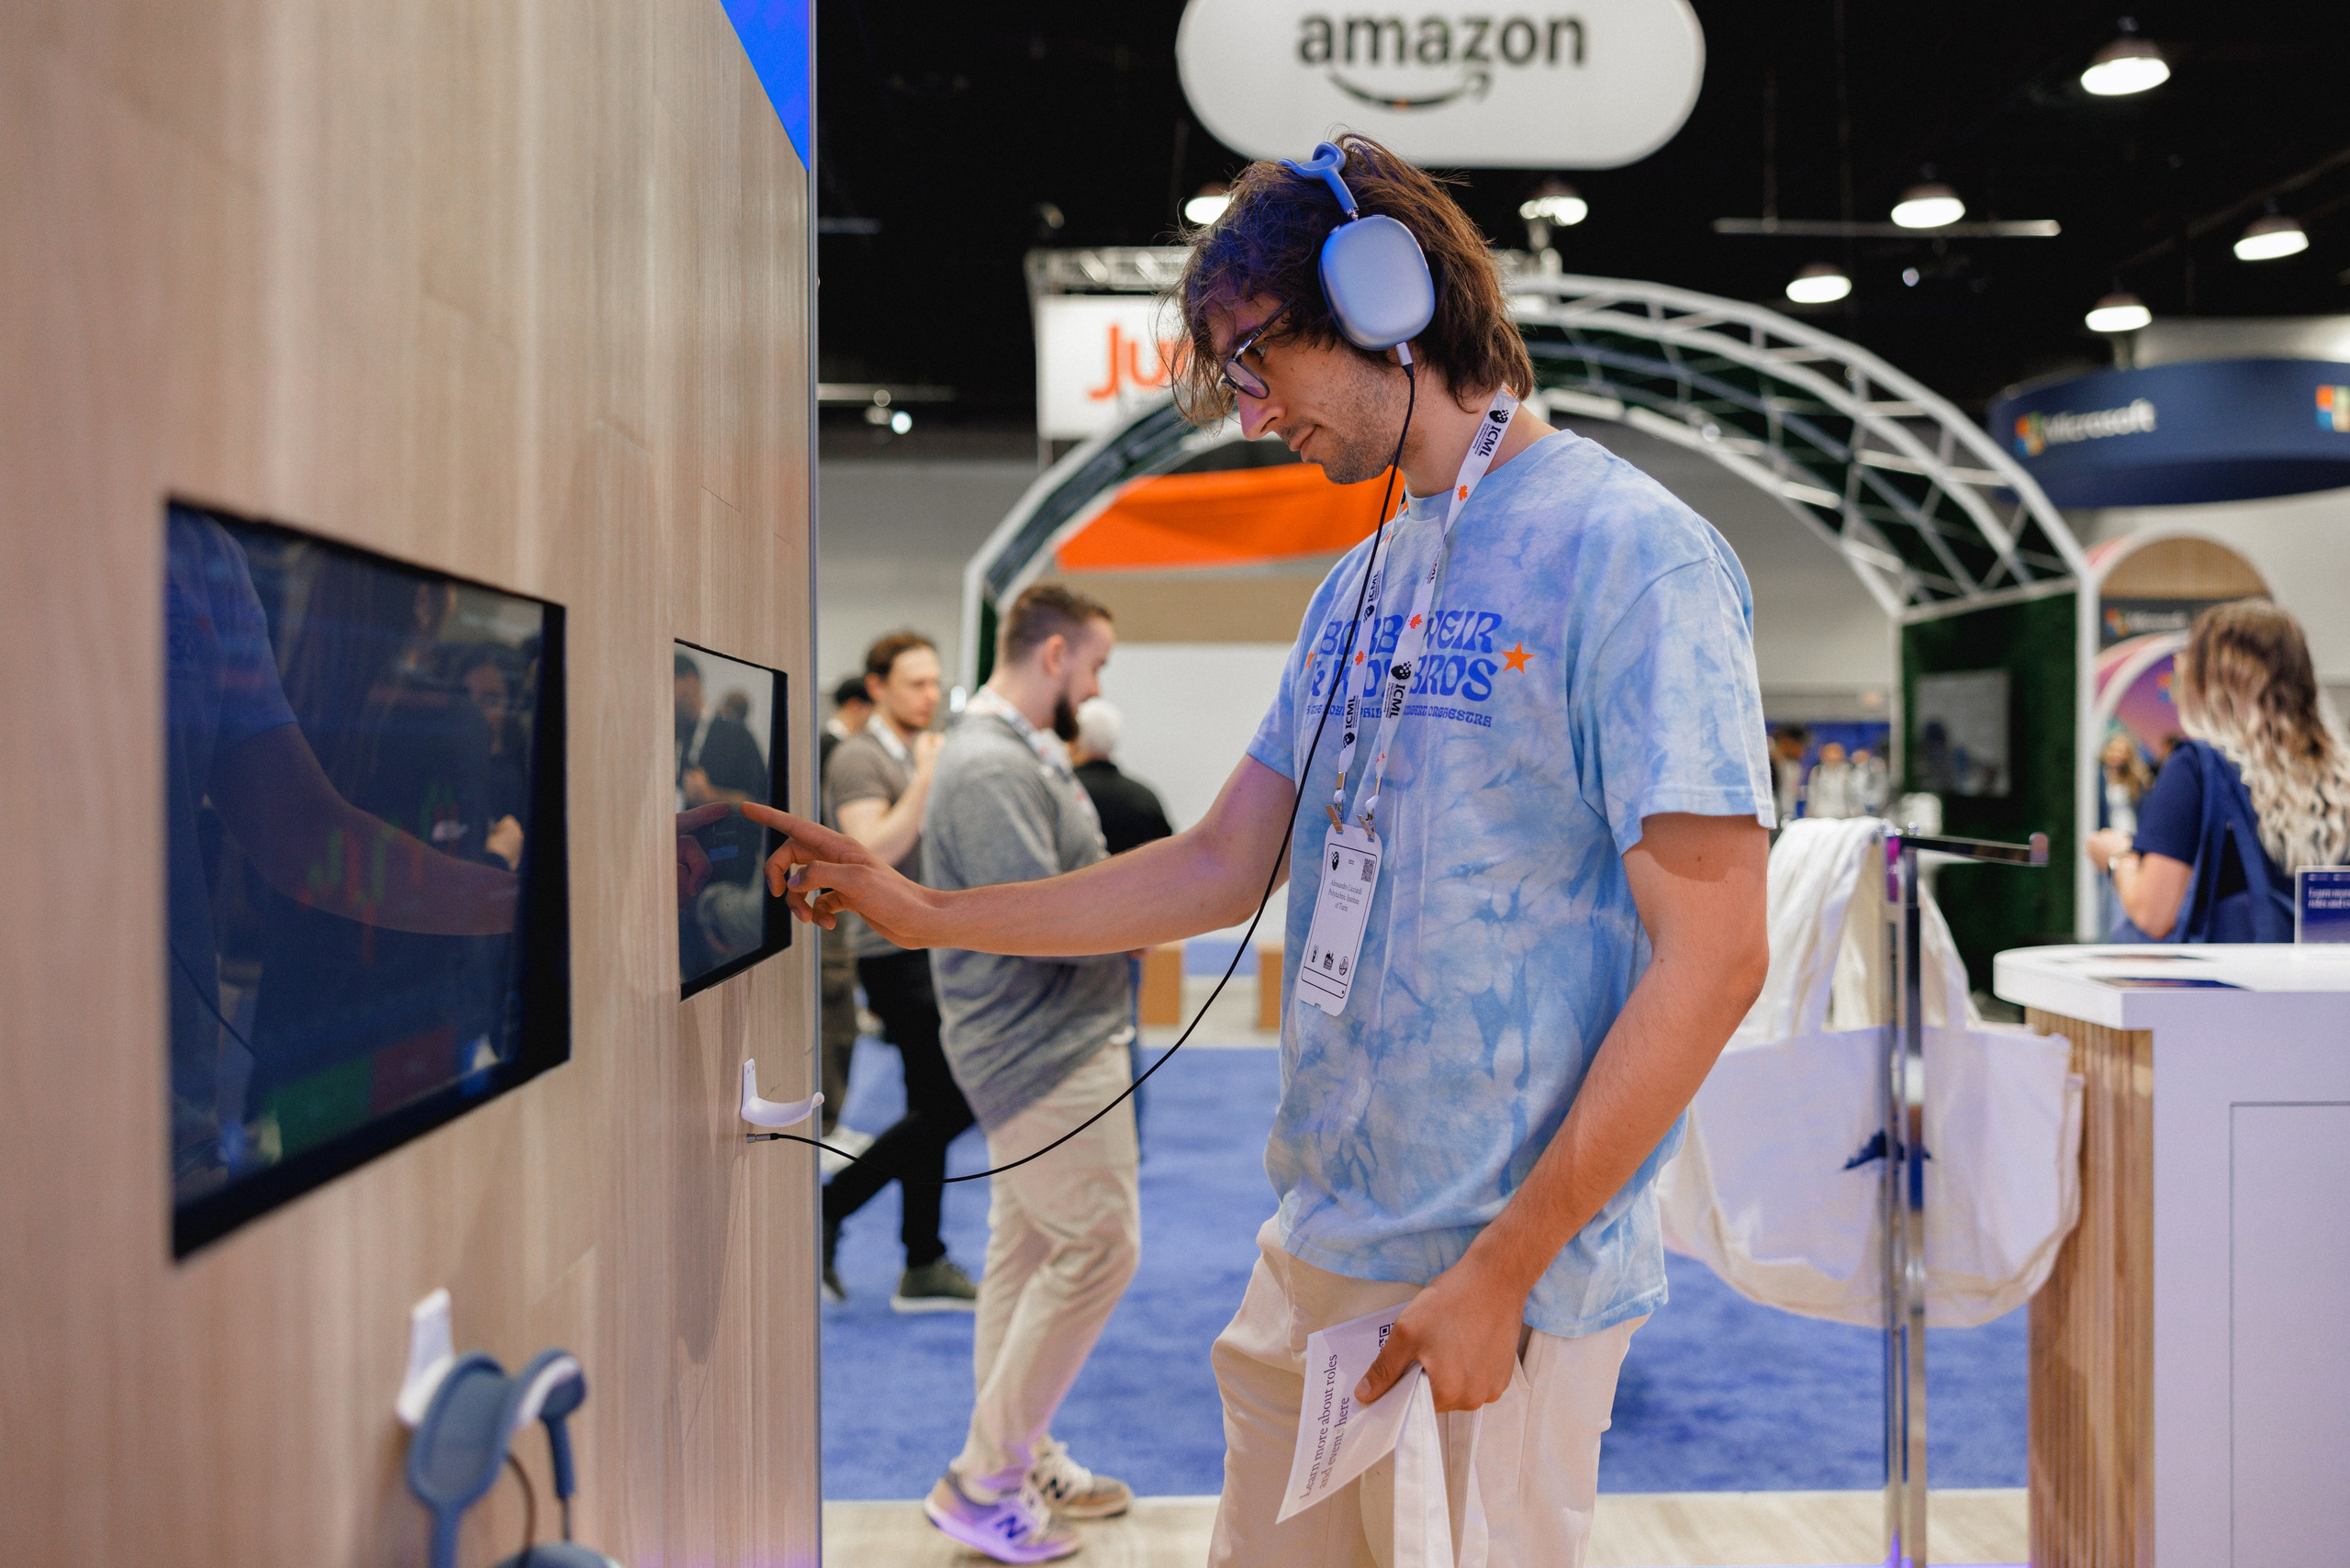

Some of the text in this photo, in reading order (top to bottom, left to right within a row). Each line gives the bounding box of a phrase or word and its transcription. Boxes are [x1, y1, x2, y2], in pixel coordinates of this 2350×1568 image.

[1297, 13, 1588, 69] amazon
[1088, 323, 1193, 400] Ju
[1479, 425, 1501, 456] ICML
[1390, 684, 1405, 718] ICML
[1410, 655, 1498, 701] BROS
[1345, 695, 1356, 728] ICML
[1427, 705, 1492, 727] ORCHESTRA
[1300, 1354, 1337, 1500] Learn more about roles
[1319, 1396, 1349, 1489] and events here
